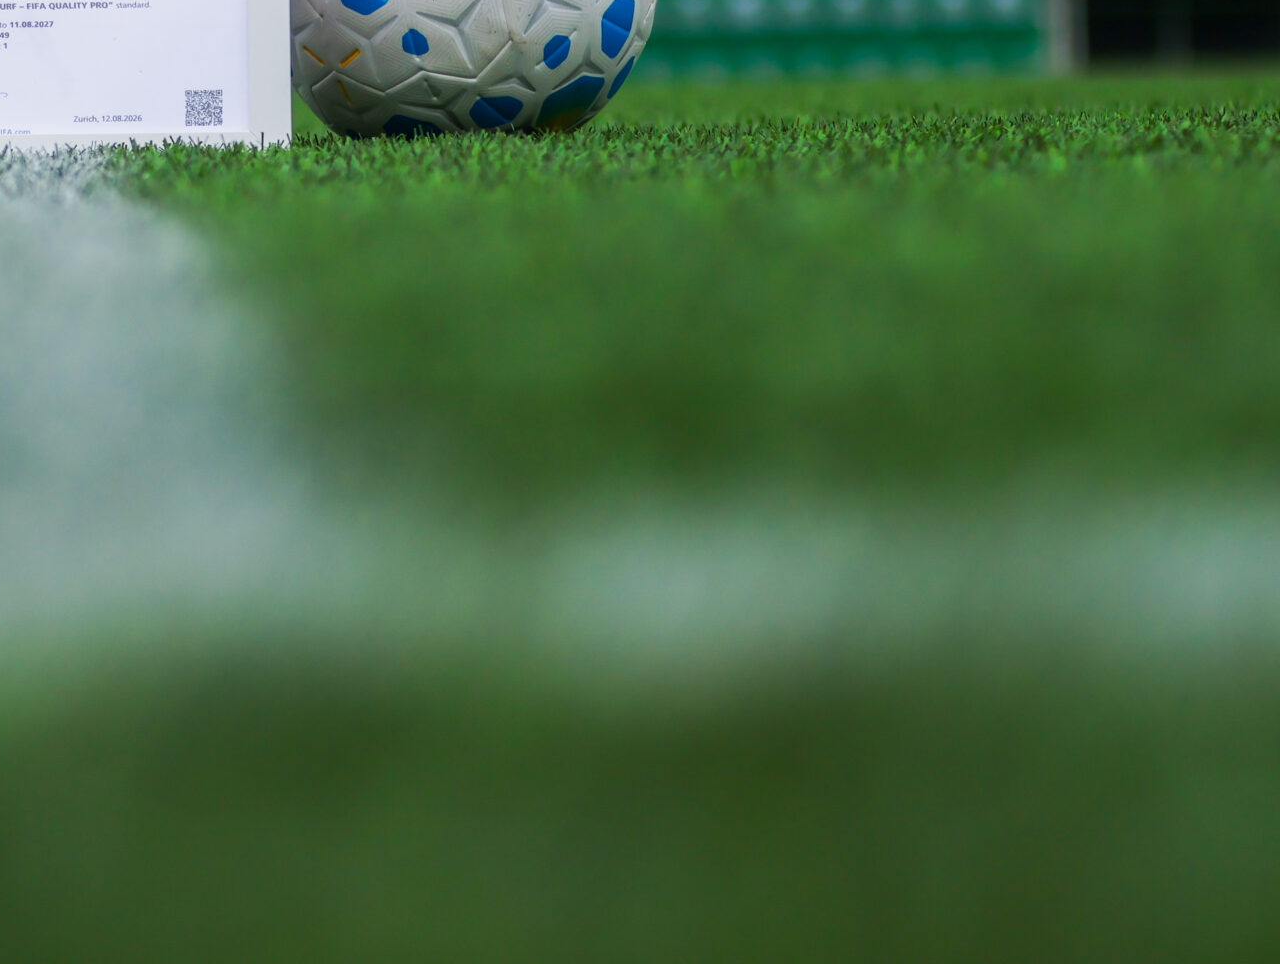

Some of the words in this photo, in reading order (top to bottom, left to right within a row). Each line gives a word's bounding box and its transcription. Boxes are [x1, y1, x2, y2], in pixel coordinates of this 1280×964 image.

[26, 2, 47, 11] FIFA
[48, 1, 88, 11] QUALITY
[9, 20, 55, 29] 11.08.2027
[73, 115, 98, 123] Zurich,
[102, 114, 143, 123] 12.08.2026
